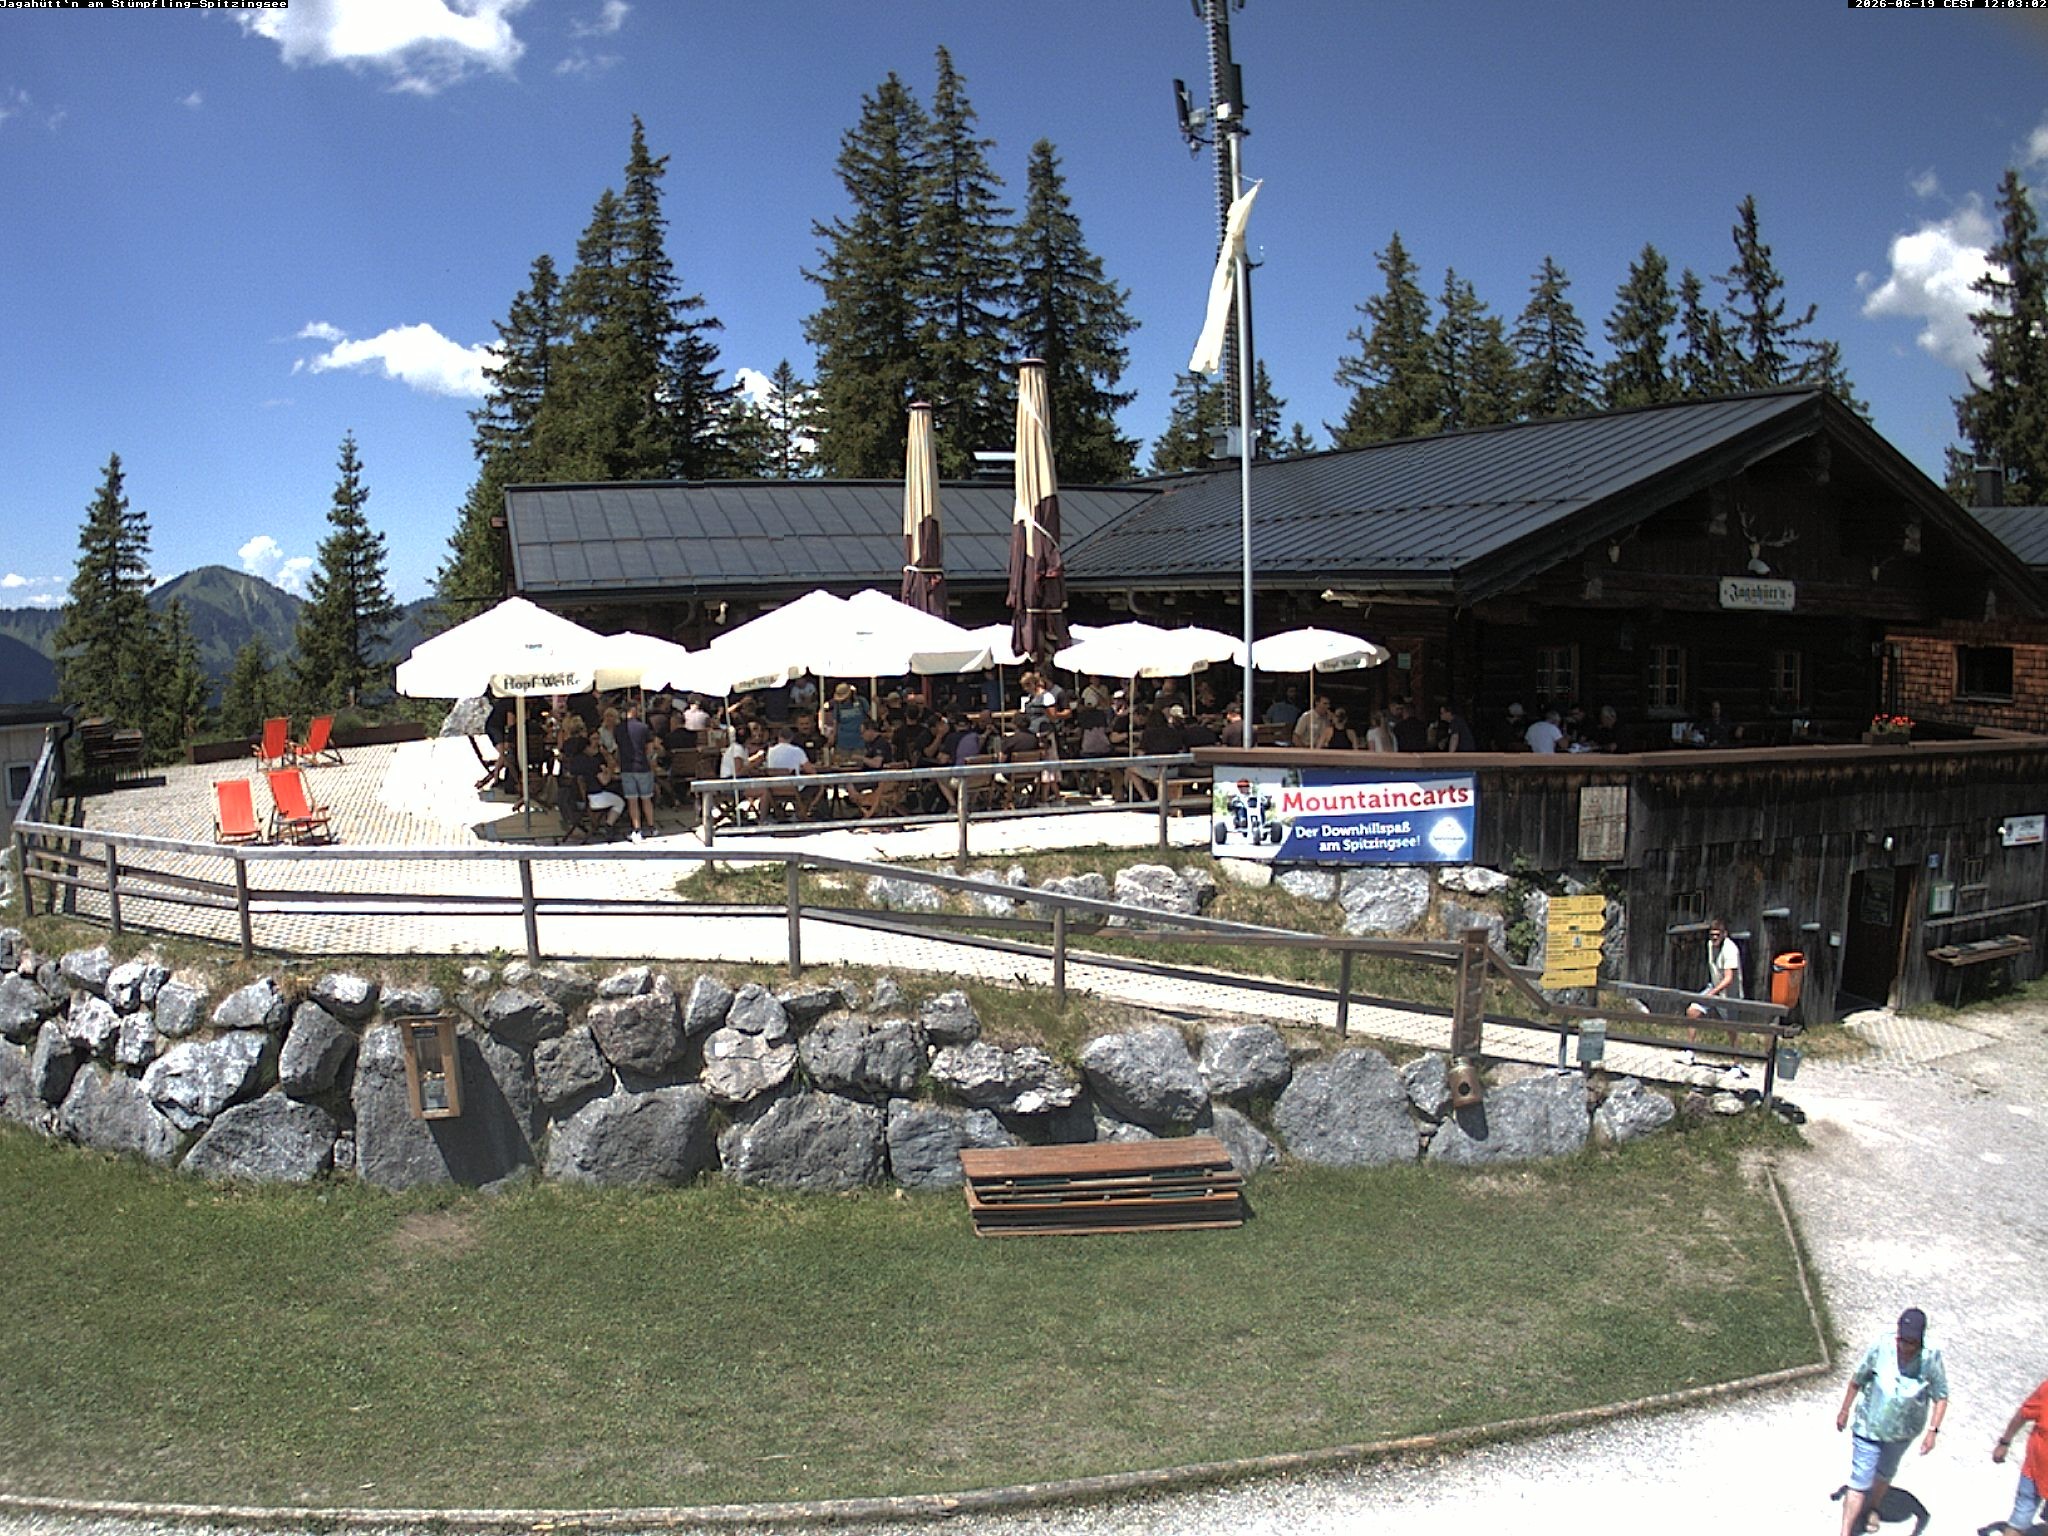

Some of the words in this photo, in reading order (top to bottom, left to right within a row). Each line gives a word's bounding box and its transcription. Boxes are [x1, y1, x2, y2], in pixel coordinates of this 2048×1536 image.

[503, 677, 538, 693] Hopf
[1282, 786, 1469, 813] Mountaincarts
[1295, 826, 1319, 839] Der
[1321, 821, 1411, 840] Downhillspaß
[1319, 841, 1341, 853] am
[1343, 835, 1421, 854] Spitzingsee!
